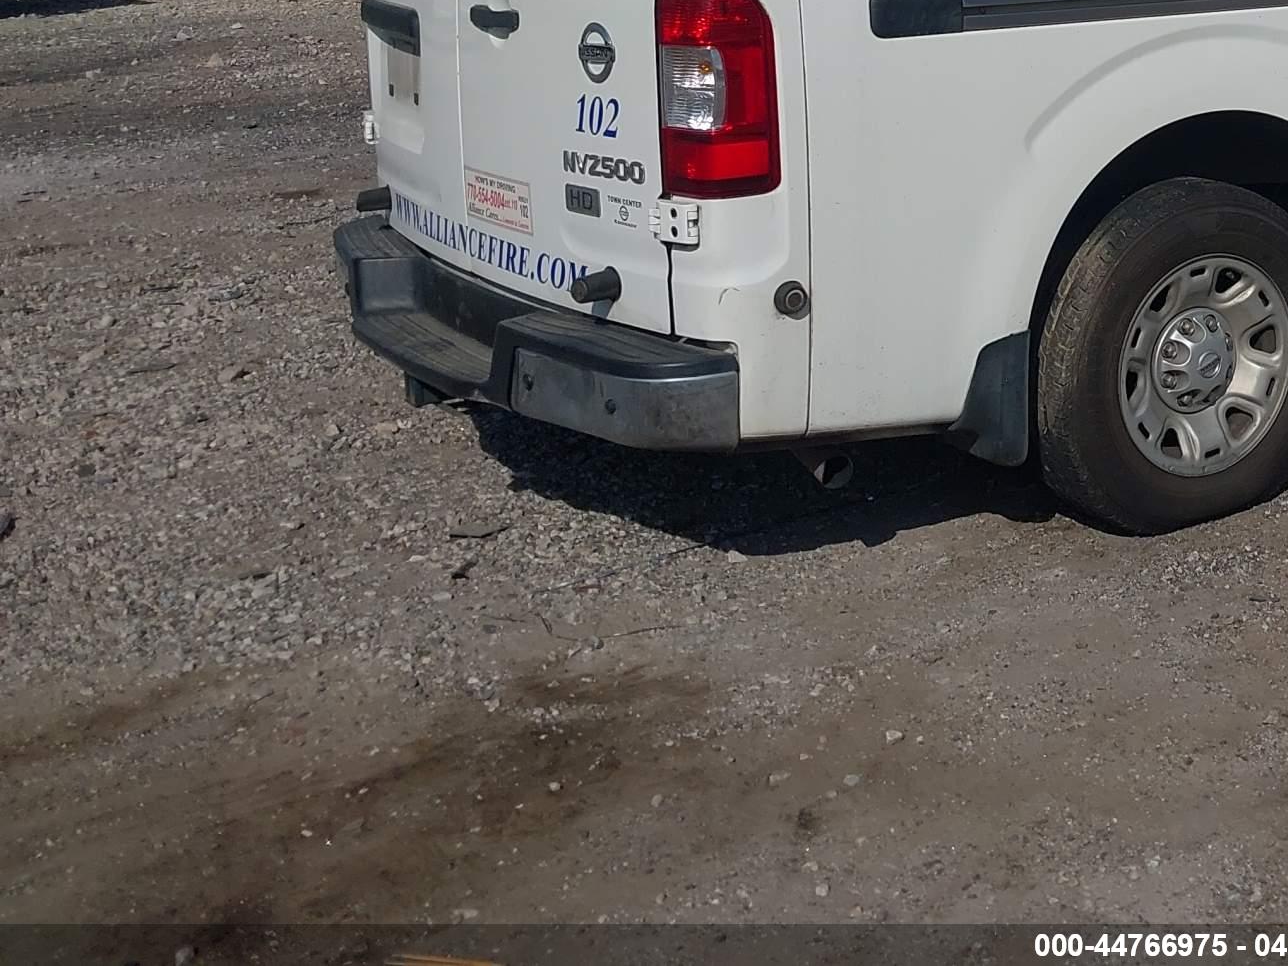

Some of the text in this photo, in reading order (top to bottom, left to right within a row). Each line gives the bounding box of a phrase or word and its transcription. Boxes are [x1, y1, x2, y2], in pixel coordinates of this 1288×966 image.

[575, 93, 619, 138] 102
[563, 150, 645, 185] NV2500
[570, 188, 594, 211] HD
[395, 192, 588, 292] WWW.ALLIANCEFIRE.COM
